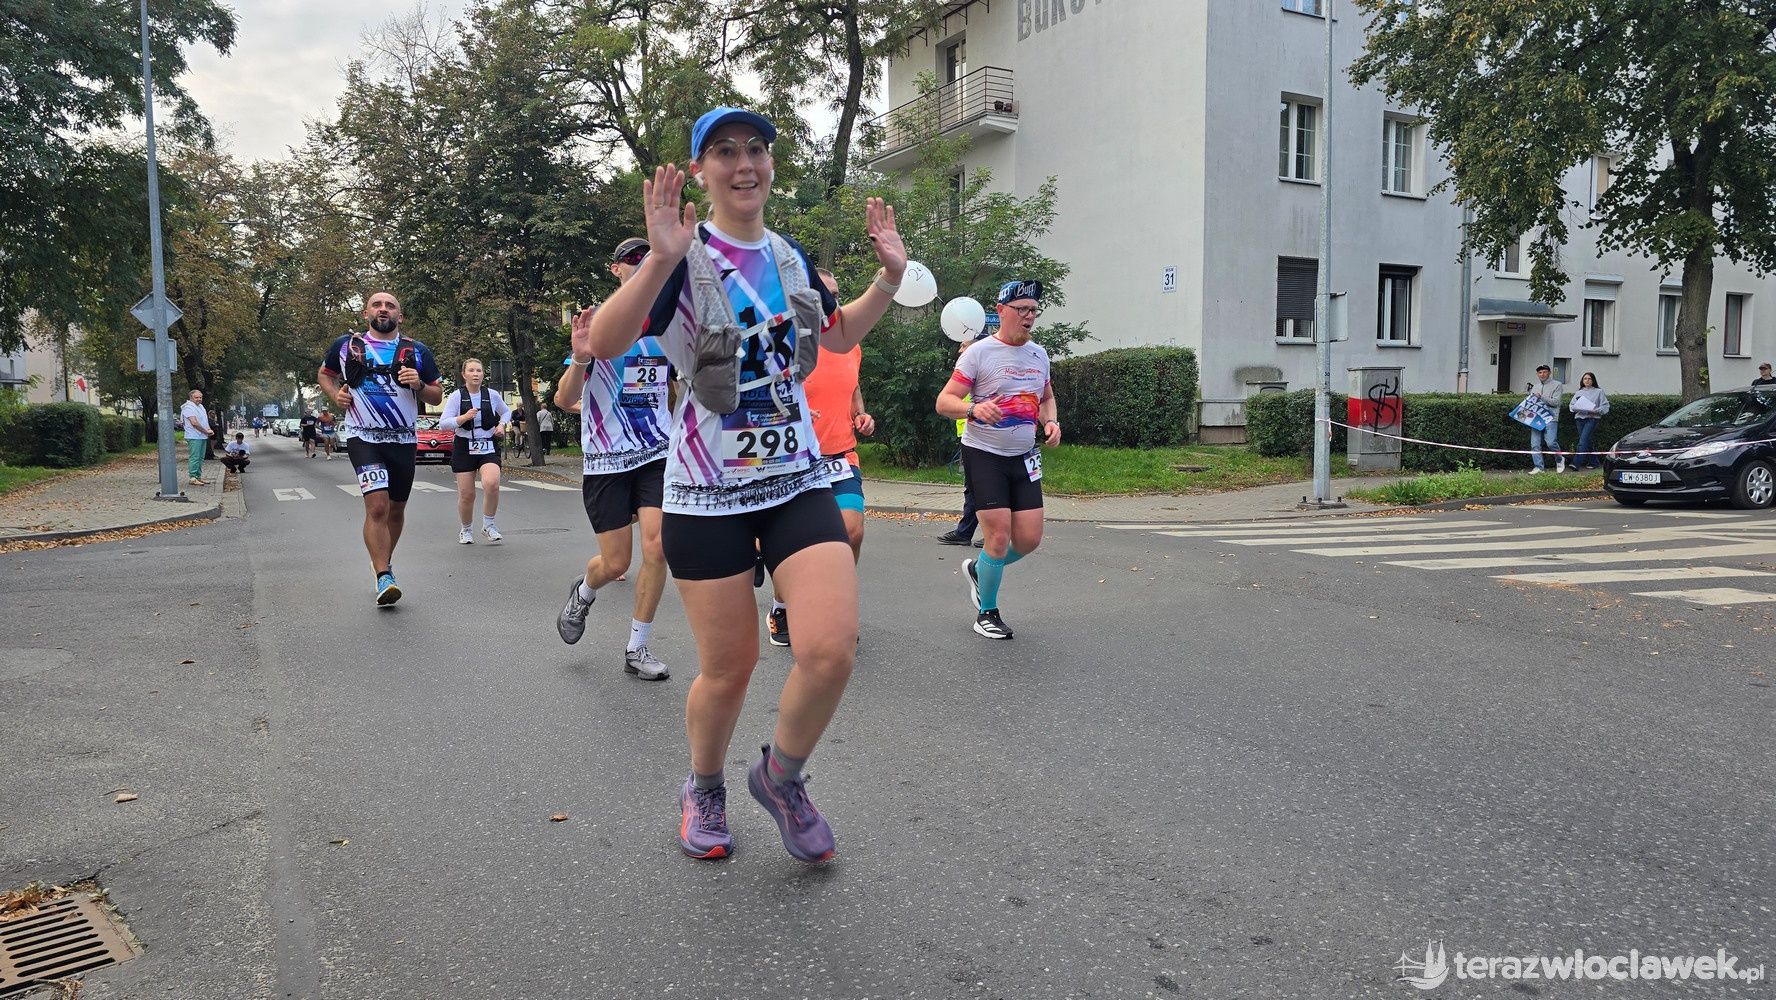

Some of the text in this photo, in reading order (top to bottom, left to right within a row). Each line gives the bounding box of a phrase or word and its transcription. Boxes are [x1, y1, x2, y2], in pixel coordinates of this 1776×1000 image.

[1164, 273, 1174, 286] 31
[1017, 281, 1036, 297] Buff
[637, 367, 657, 382] 28
[473, 441, 489, 450] 271
[736, 426, 798, 458] 298
[362, 470, 386, 484] 400
